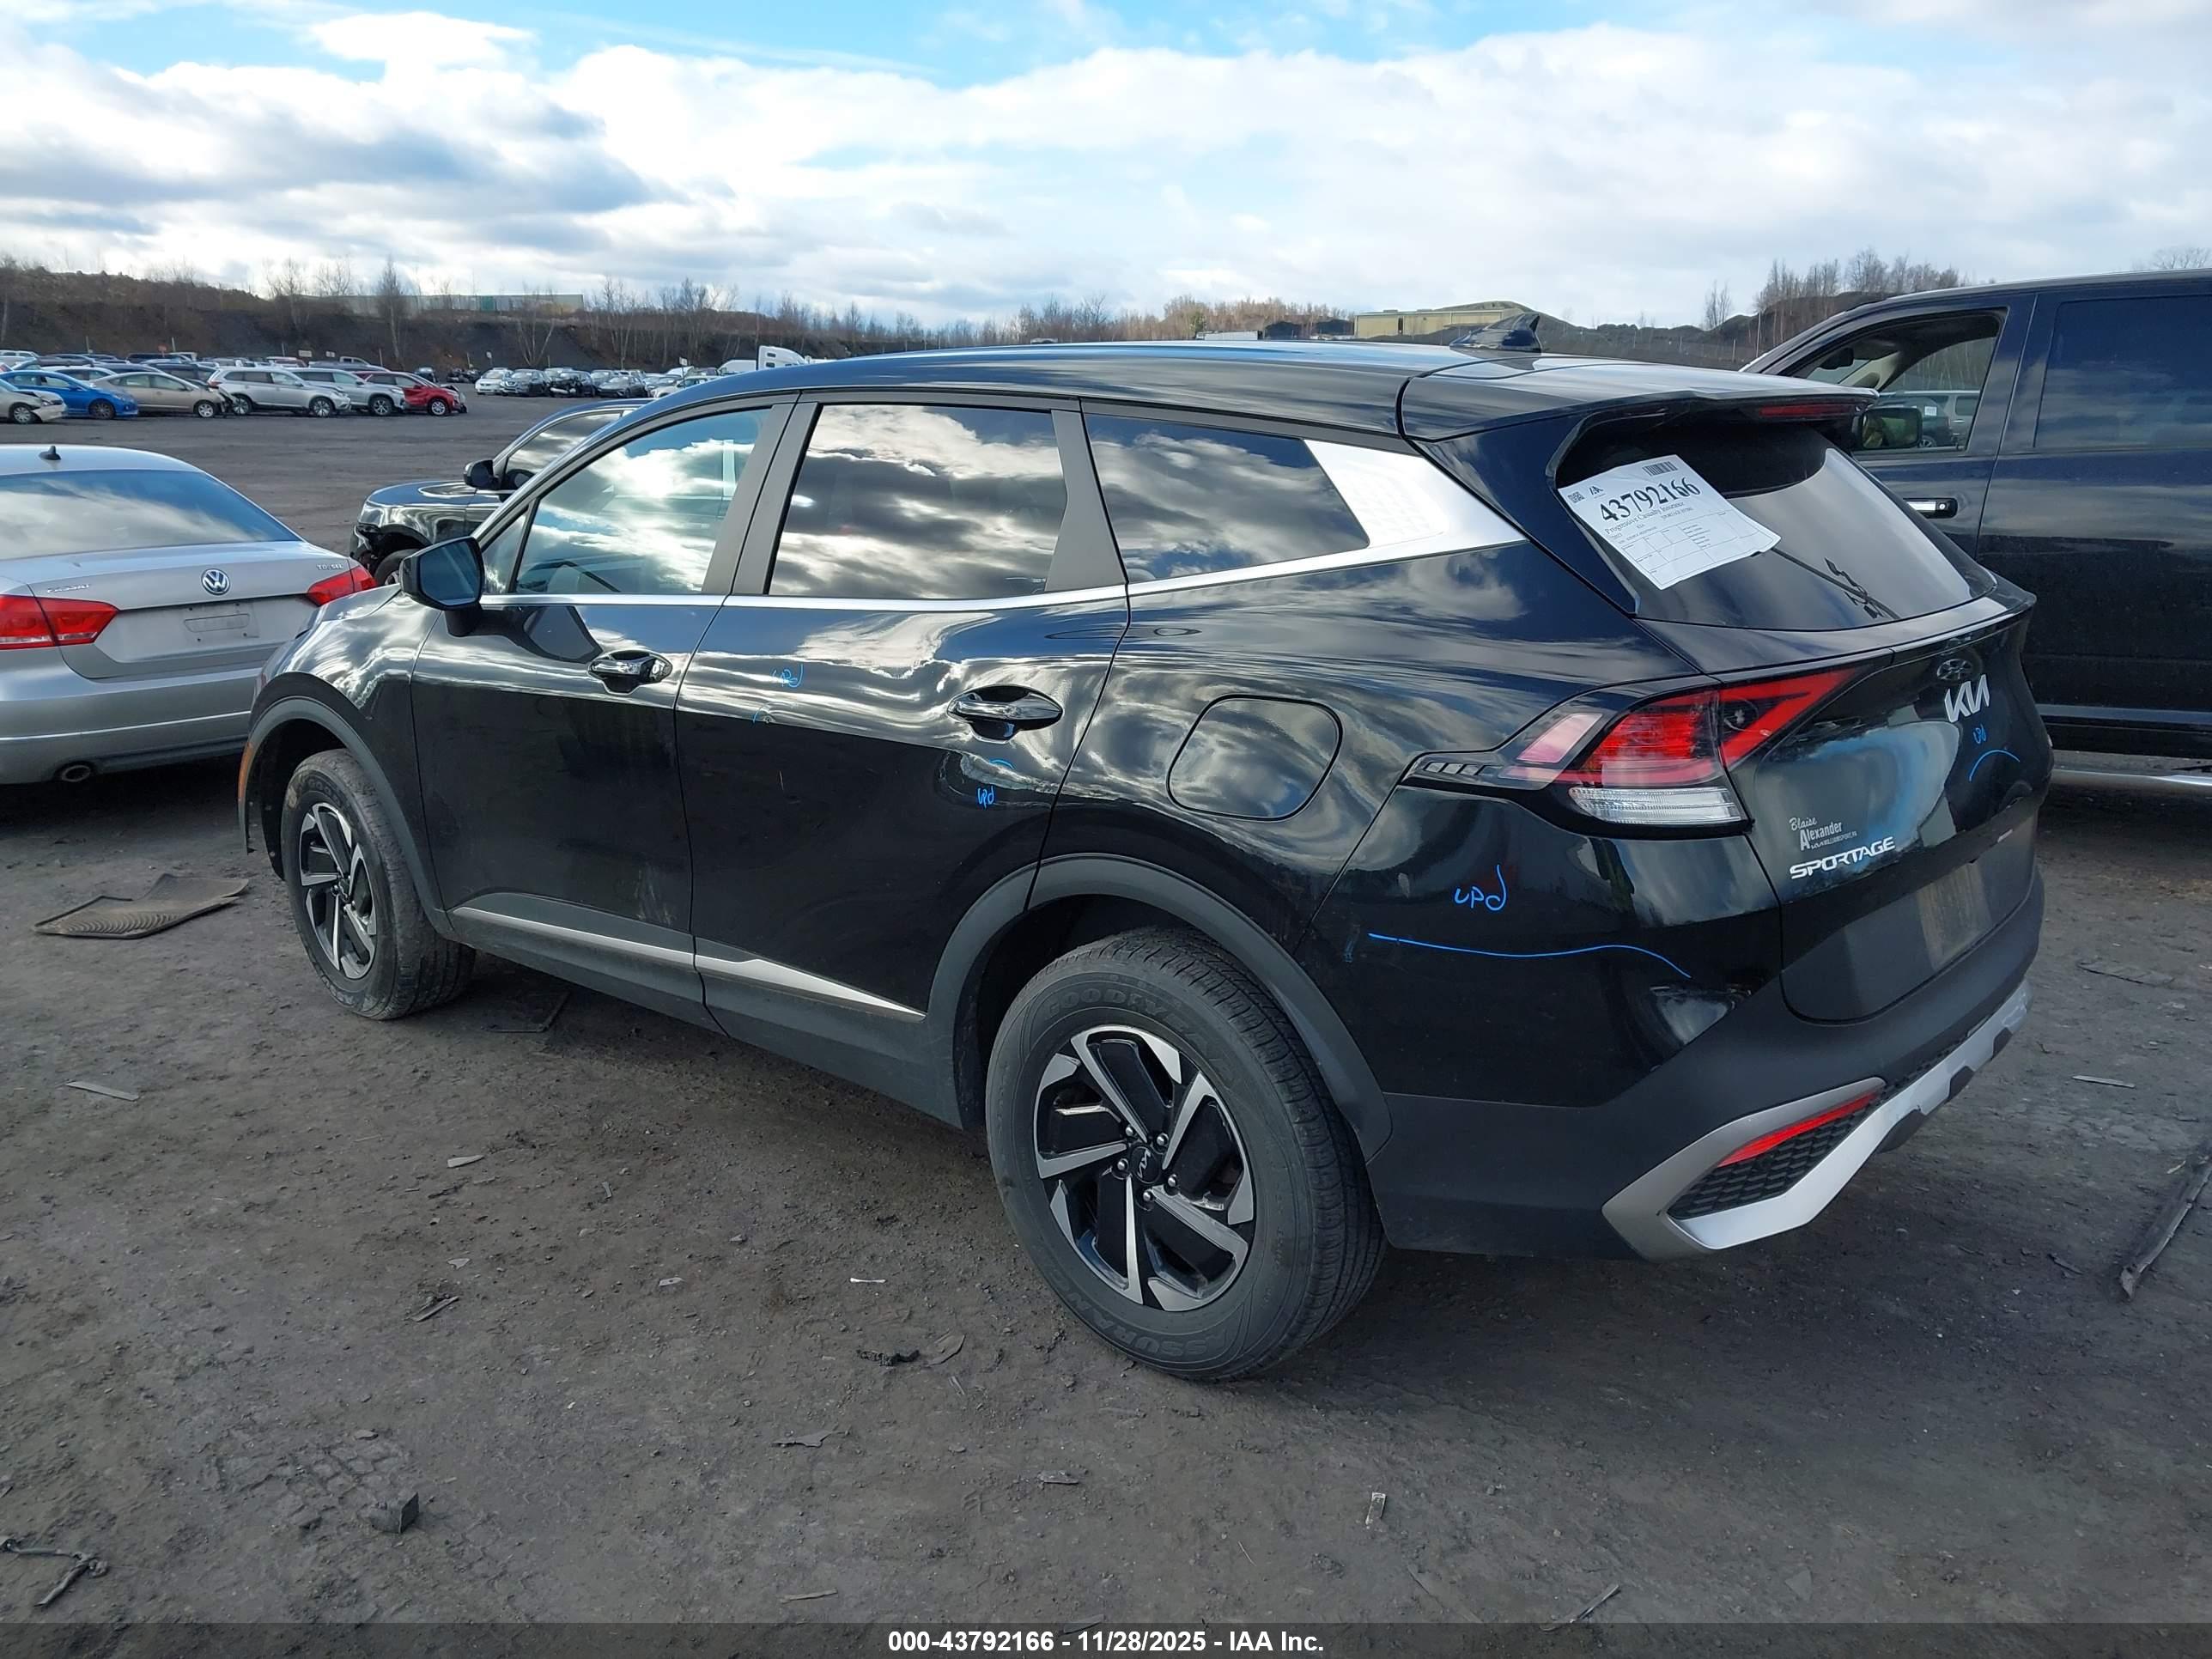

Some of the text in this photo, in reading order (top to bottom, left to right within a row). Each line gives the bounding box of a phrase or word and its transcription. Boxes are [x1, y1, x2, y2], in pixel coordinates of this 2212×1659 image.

[1600, 477, 1701, 521] 43792166
[1789, 817, 1818, 831] Blaise
[1800, 822, 1843, 851] Alexander
[1790, 836, 1896, 879] SPORTAGE
